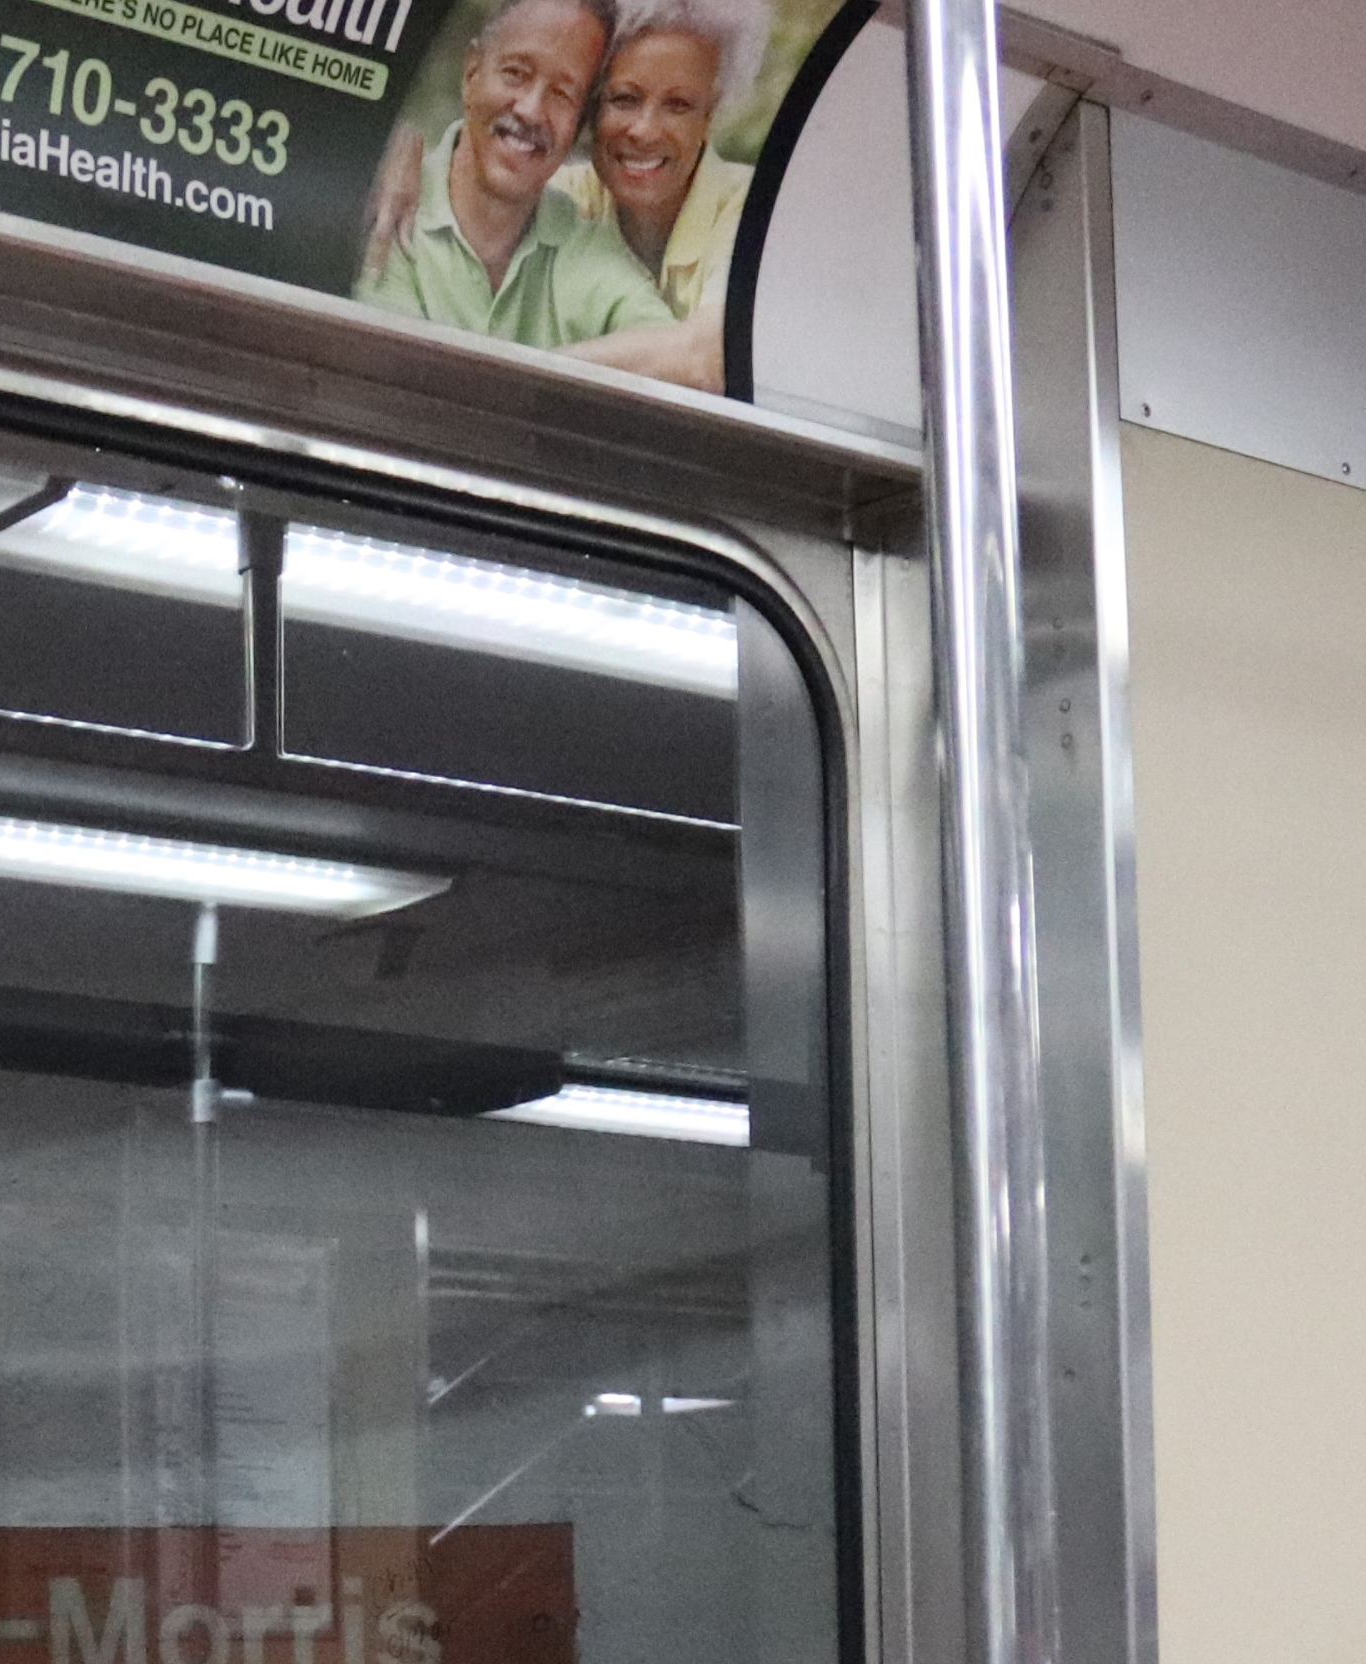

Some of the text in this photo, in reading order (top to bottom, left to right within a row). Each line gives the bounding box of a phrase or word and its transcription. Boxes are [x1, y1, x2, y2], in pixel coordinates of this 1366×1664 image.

[142, 3, 174, 32] NO
[181, 14, 255, 55] PLACE
[258, 37, 309, 70] LIKE
[311, 52, 376, 91] HOME
